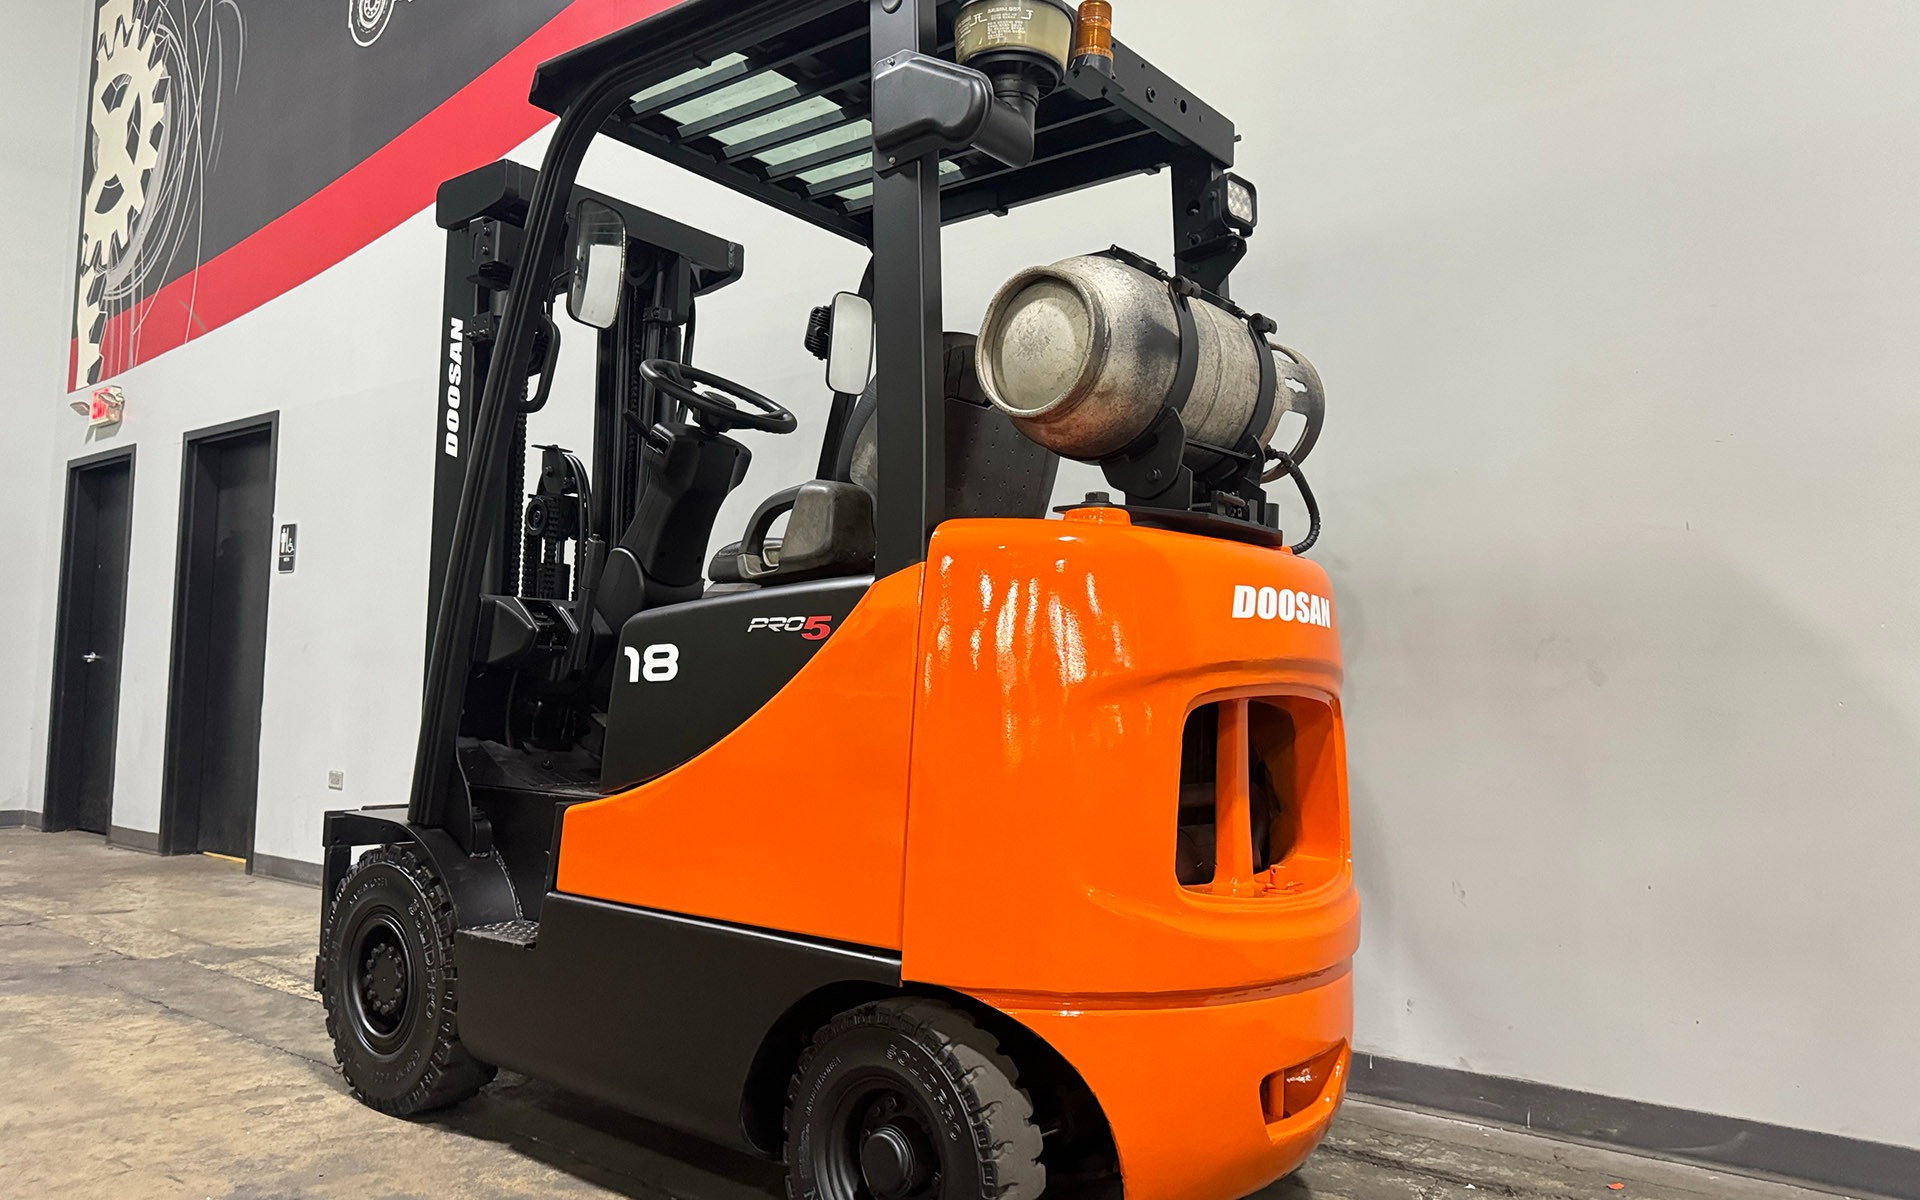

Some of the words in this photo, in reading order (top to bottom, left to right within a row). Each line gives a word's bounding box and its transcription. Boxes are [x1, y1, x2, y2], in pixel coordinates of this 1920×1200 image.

[445, 317, 464, 458] DOOSAN
[1231, 584, 1331, 629] DOOSAN
[624, 643, 679, 683] 18
